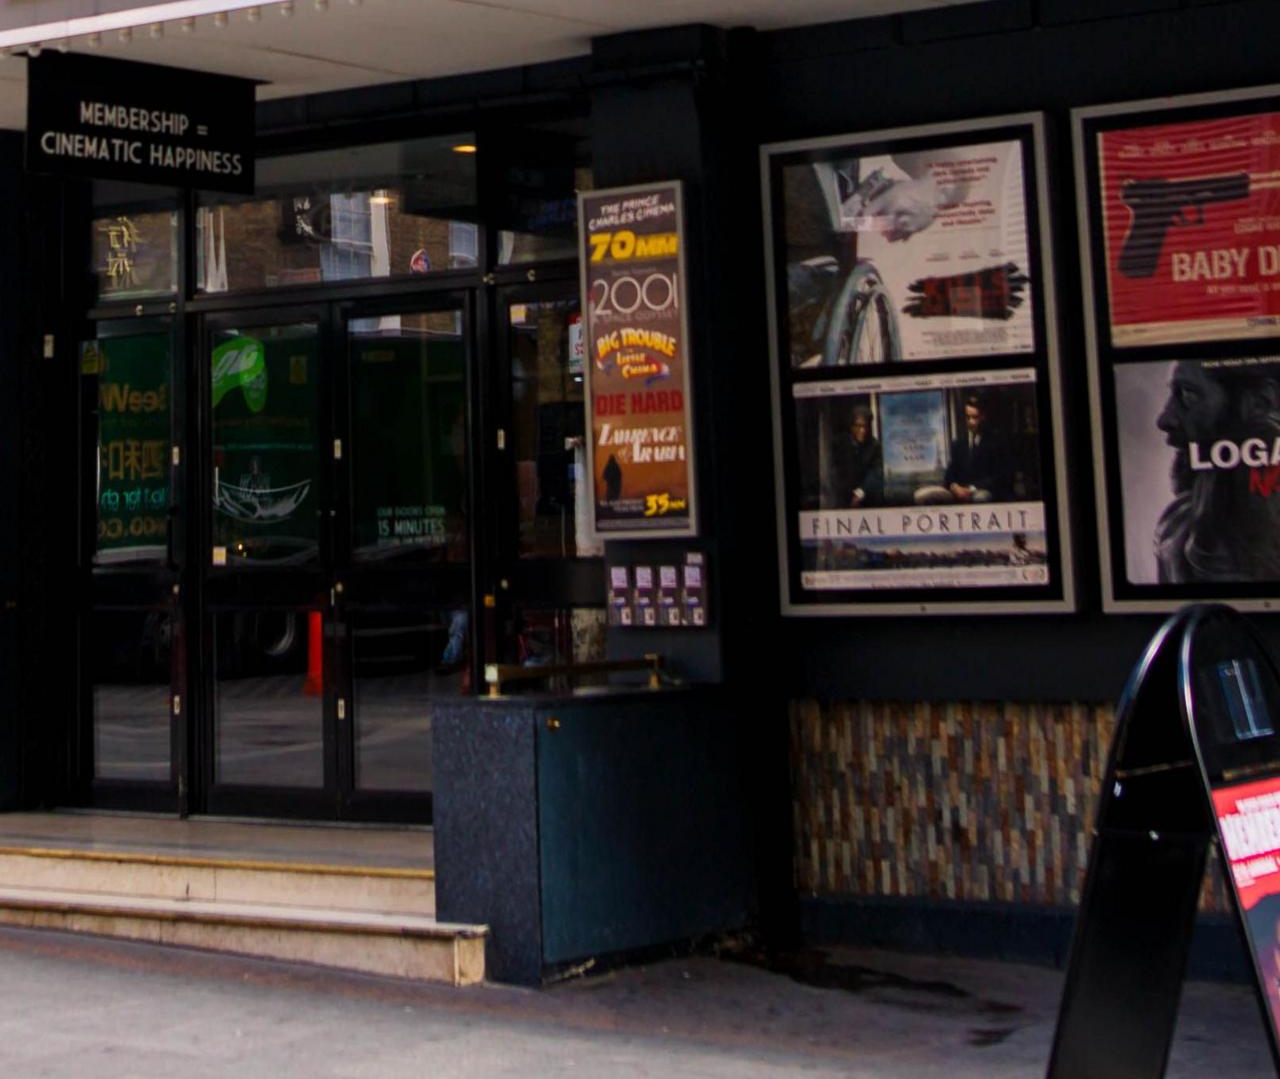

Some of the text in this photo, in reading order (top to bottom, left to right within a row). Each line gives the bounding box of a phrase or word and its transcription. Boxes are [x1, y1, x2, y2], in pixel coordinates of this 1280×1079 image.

[80, 101, 189, 136] MEMBERSHIP
[41, 131, 242, 175] CINEMATIC HAPPINESS
[1172, 247, 1251, 282] BABY
[592, 273, 679, 316] 2001
[596, 331, 619, 358] BIG
[620, 327, 677, 359] TROUBLE
[596, 389, 683, 417] DIE HARD
[377, 517, 446, 537] 15 MINUTES
[812, 509, 1028, 536] FINAL PORTRAIT
